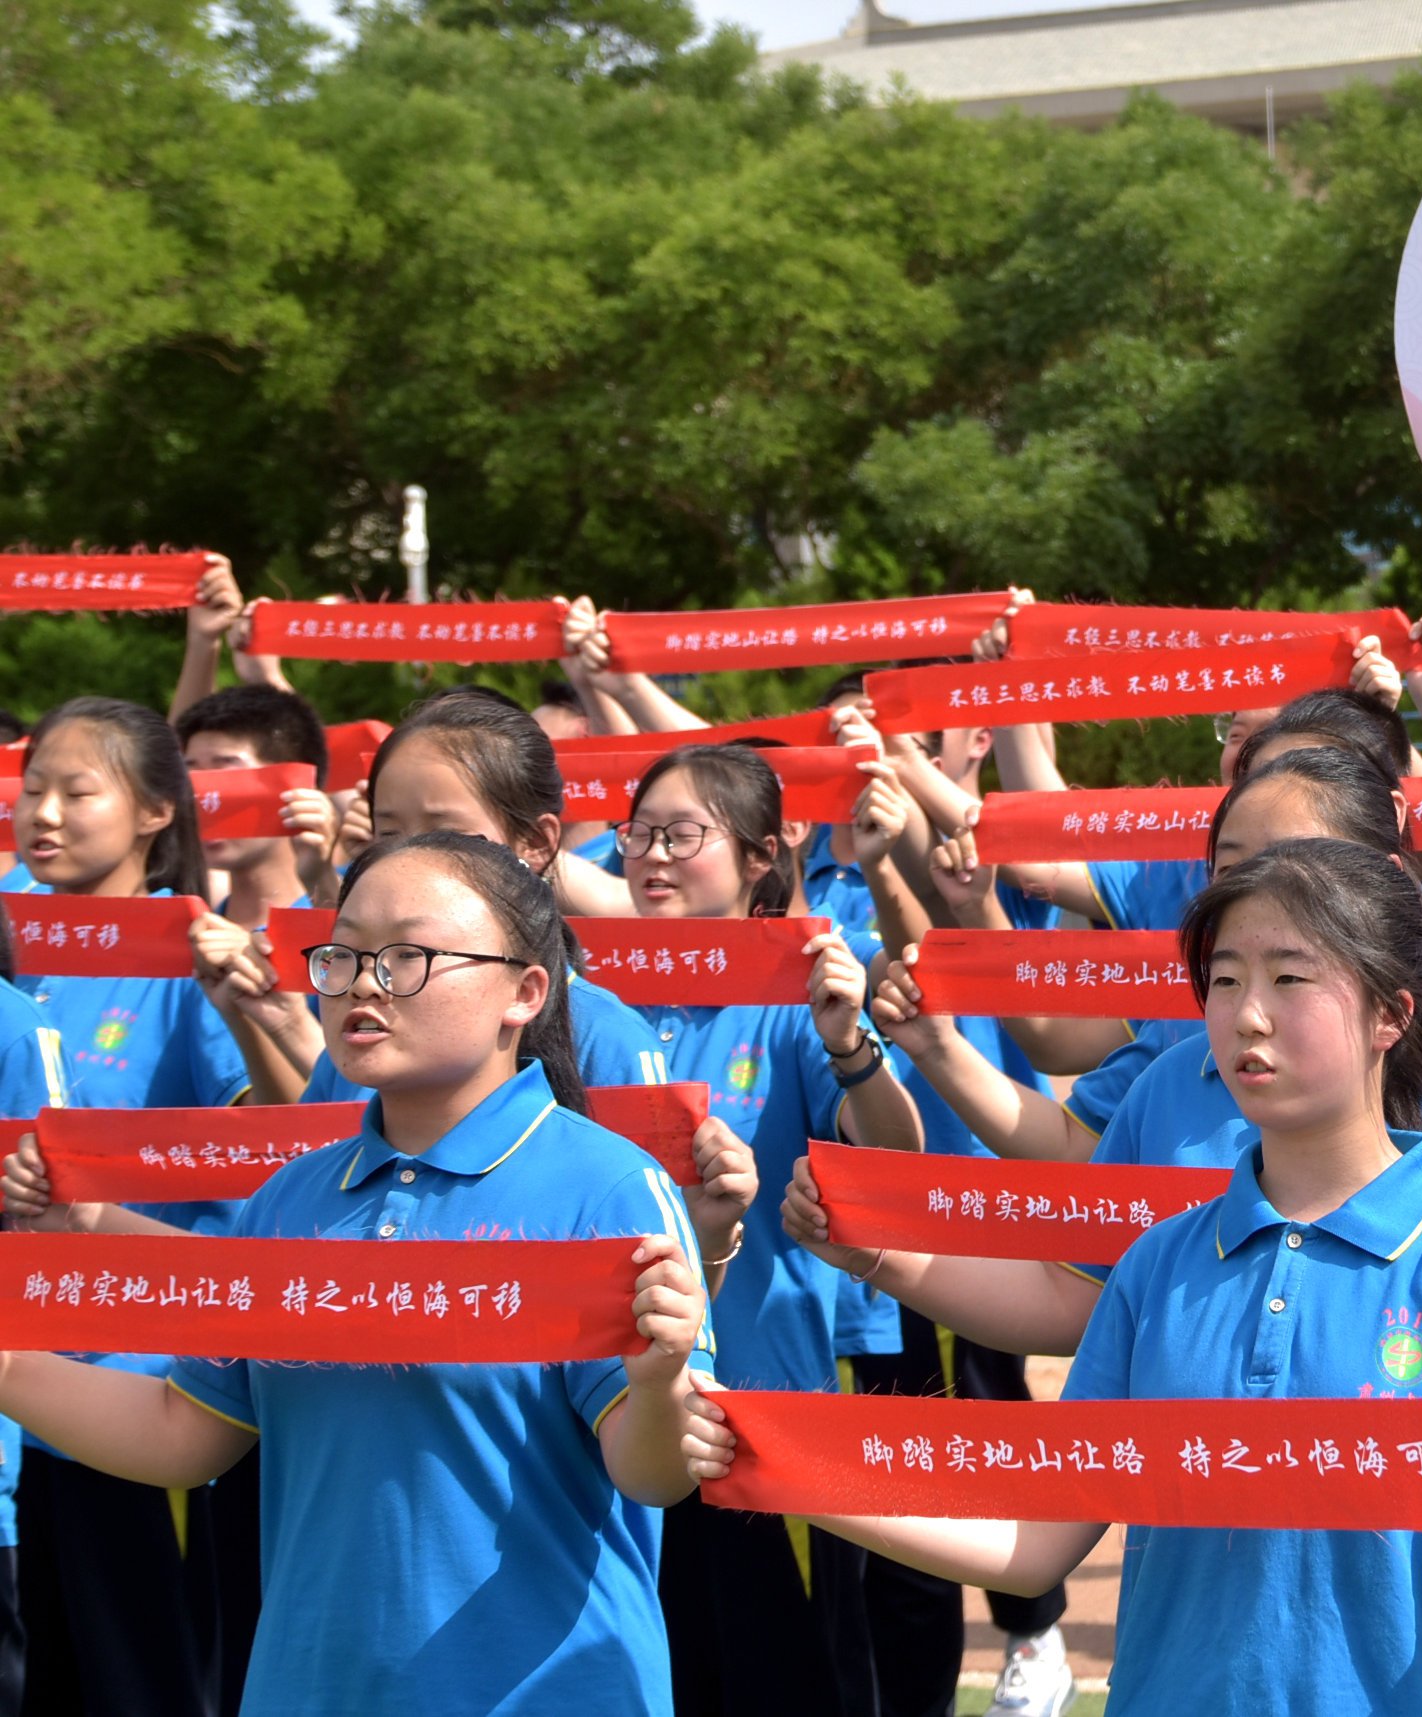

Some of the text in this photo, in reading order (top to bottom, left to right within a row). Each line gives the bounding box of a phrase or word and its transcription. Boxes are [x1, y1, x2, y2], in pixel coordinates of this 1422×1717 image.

[665, 616, 949, 651] 脚踏实地山让路 持之以恒海可移
[949, 664, 1286, 708] 不经三思不求教 不动笔墨不读书
[1062, 809, 1211, 835] 脚踏实地山让
[1015, 959, 1189, 988] 脚踏实地山让
[928, 1187, 1156, 1229] 脚踏实地山让路
[23, 1270, 522, 1319] 脚踏实地山让路 持之以恒海可移
[862, 1434, 1145, 1475] 脚踏实地山让路
